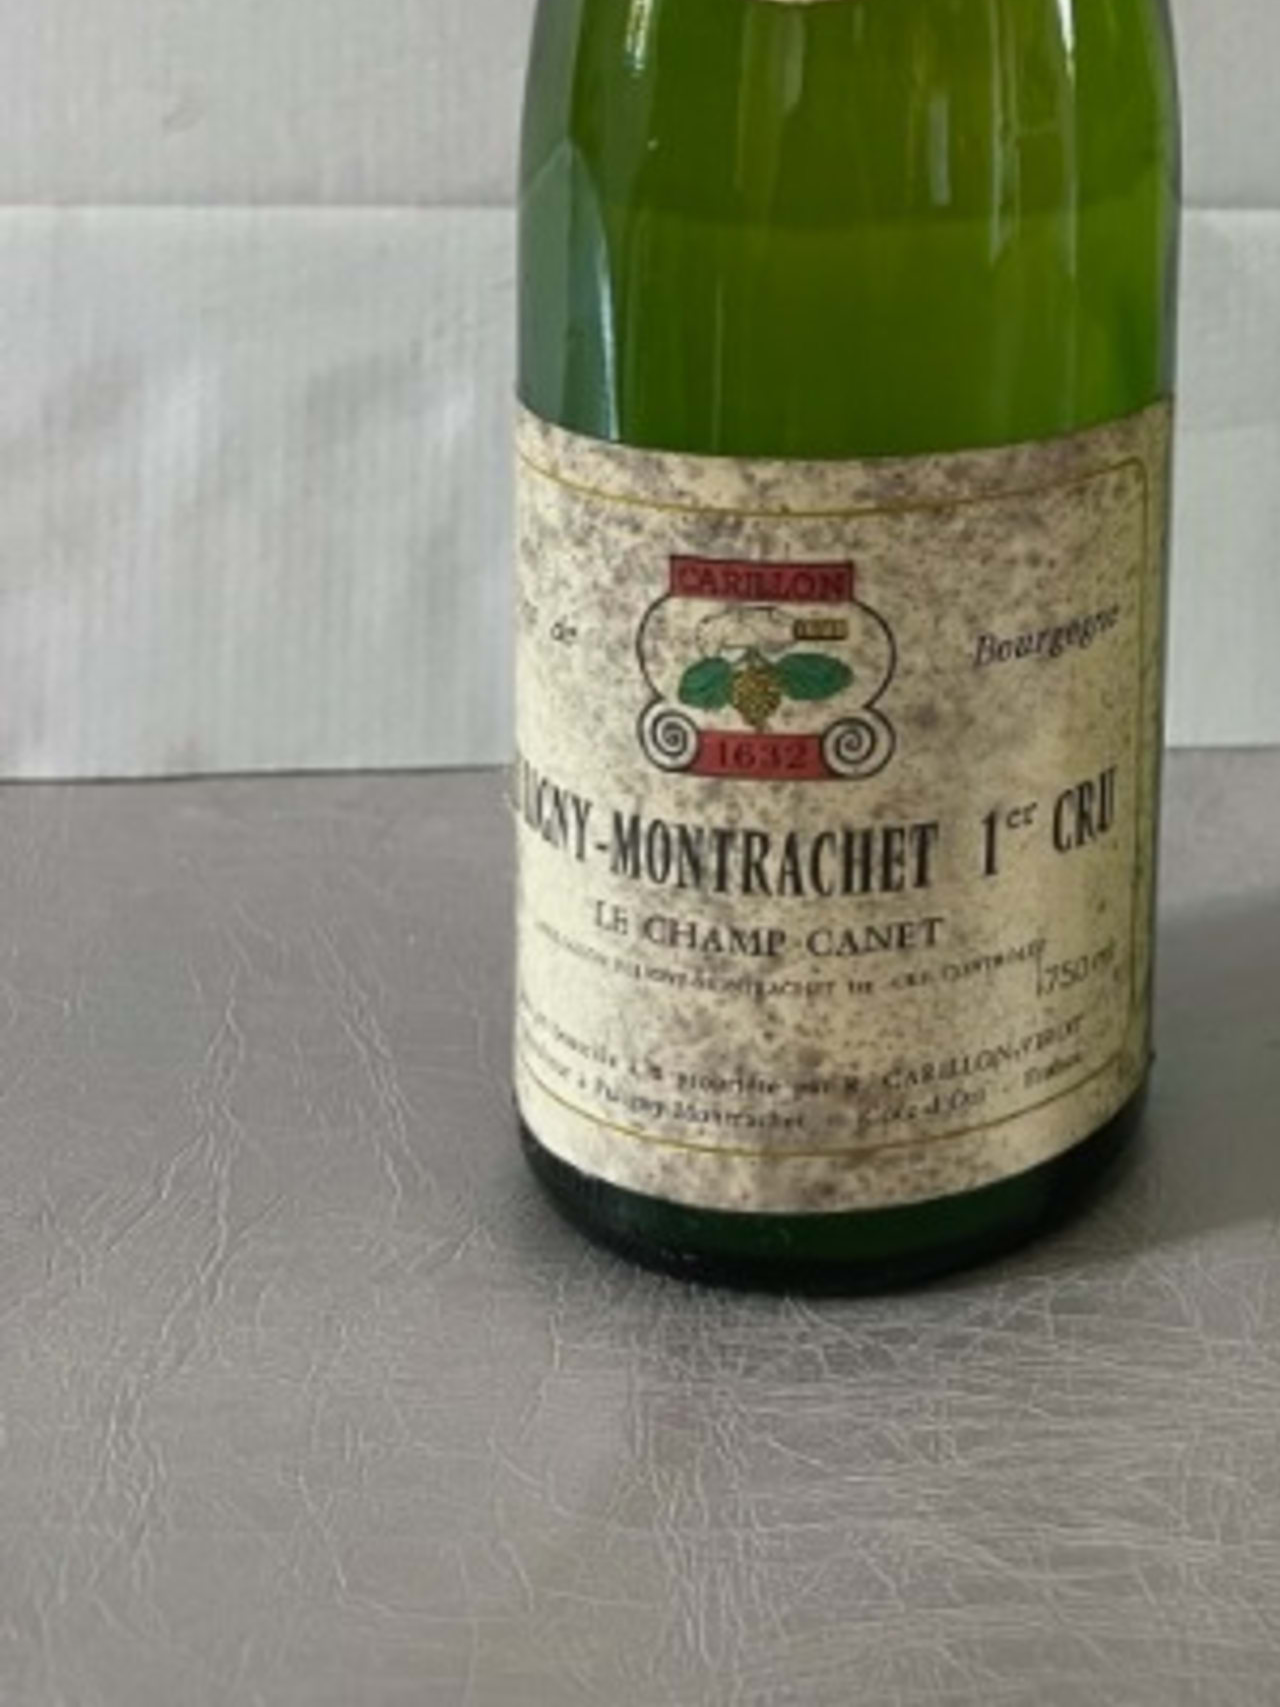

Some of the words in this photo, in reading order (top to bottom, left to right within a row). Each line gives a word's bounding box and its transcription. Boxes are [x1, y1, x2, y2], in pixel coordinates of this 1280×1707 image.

[678, 566, 846, 600] CARILLON
[972, 602, 1121, 670] Bourgogne
[716, 740, 809, 770] 1632
[1052, 764, 1118, 854] CRU
[594, 899, 629, 935] LE
[643, 913, 787, 957] CHAMP
[806, 916, 945, 957] CANET
